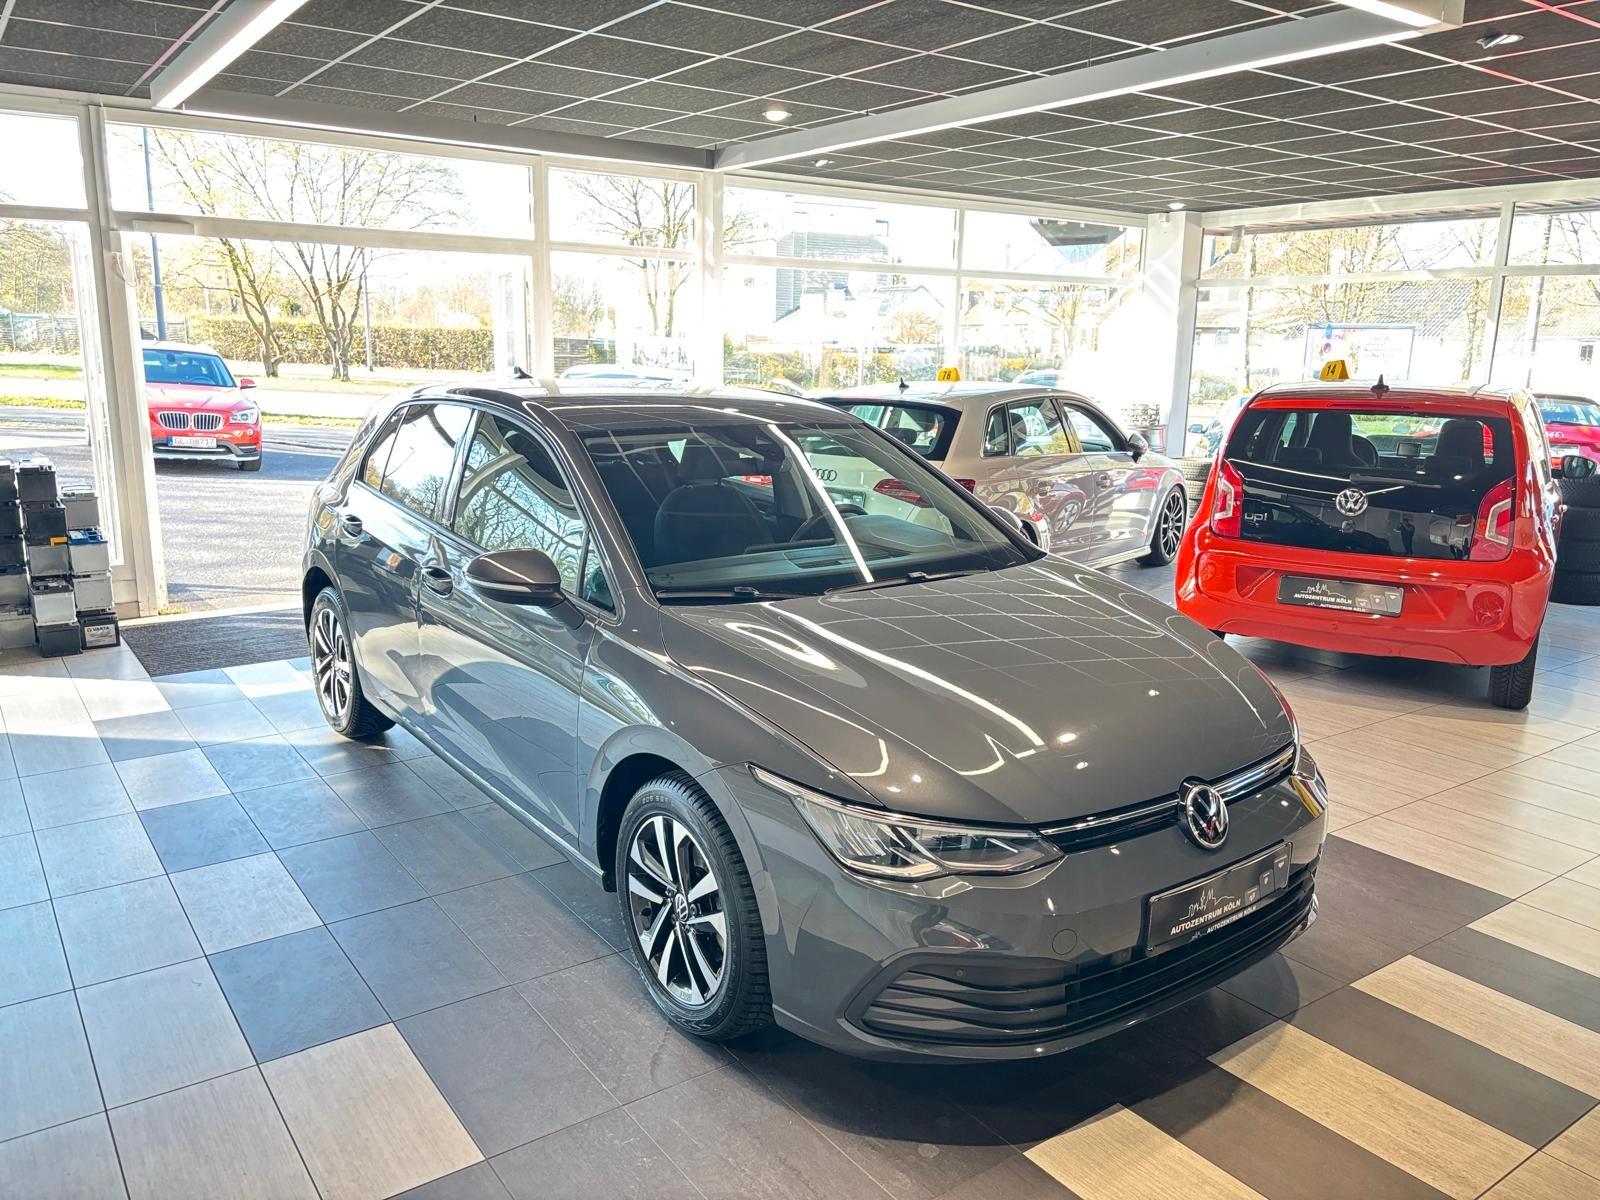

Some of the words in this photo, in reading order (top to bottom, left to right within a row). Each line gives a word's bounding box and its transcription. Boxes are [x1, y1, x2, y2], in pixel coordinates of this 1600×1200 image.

[1326, 363, 1337, 376] 14
[1244, 512, 1268, 522] up!
[1294, 593, 1335, 603] AUTOZENTRUM
[1170, 907, 1223, 935] AUTOZENTRUM
[1223, 899, 1241, 913] KÖLN
[1207, 912, 1243, 933] AUTOZENTRUM
[1243, 906, 1257, 917] KÖLN
